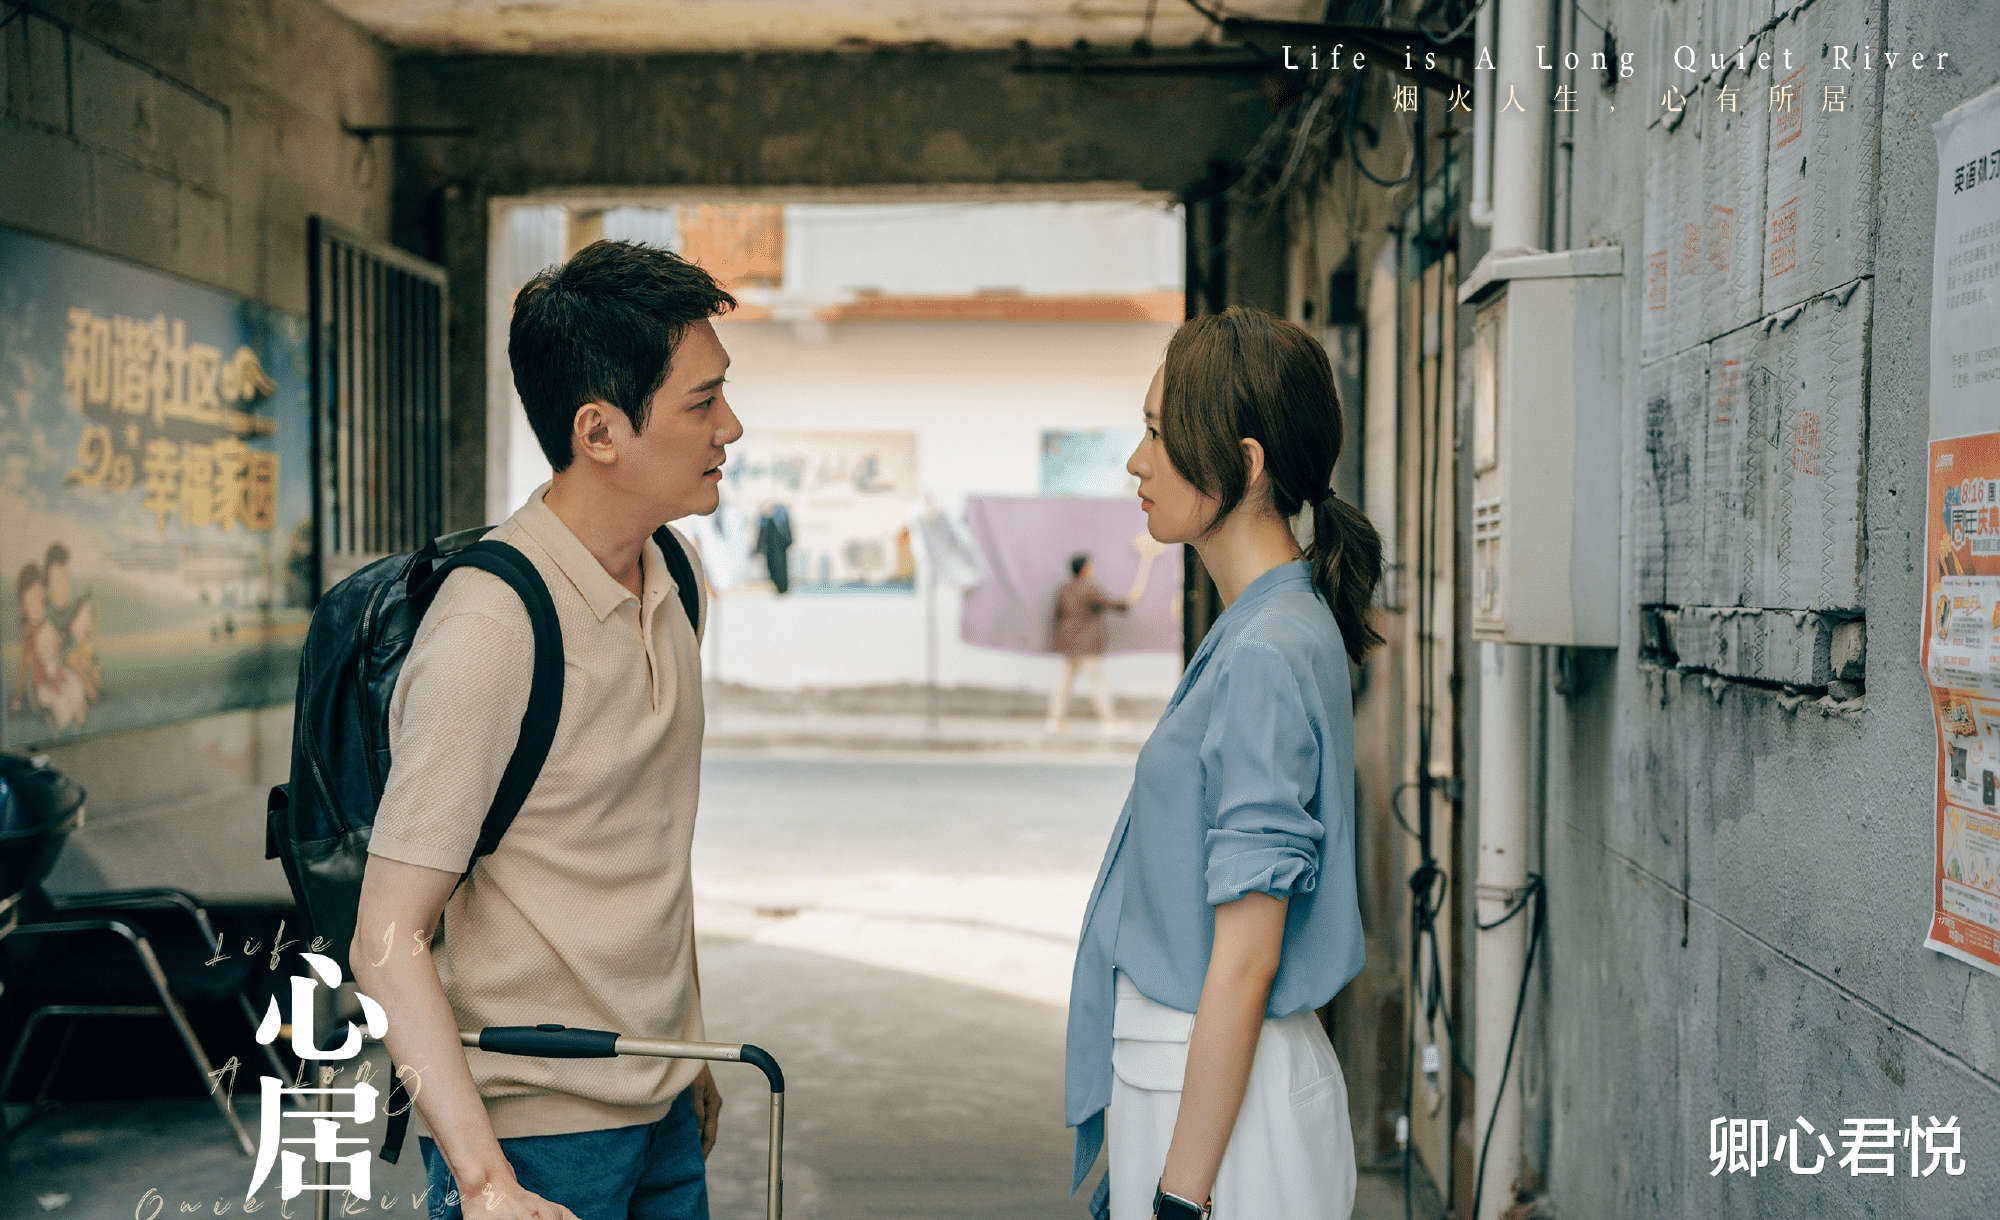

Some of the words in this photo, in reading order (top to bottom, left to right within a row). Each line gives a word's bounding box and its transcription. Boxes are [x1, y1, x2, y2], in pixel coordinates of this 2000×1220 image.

[64, 307, 250, 430] 和谐社区
[142, 435, 278, 534] 幸福家园
